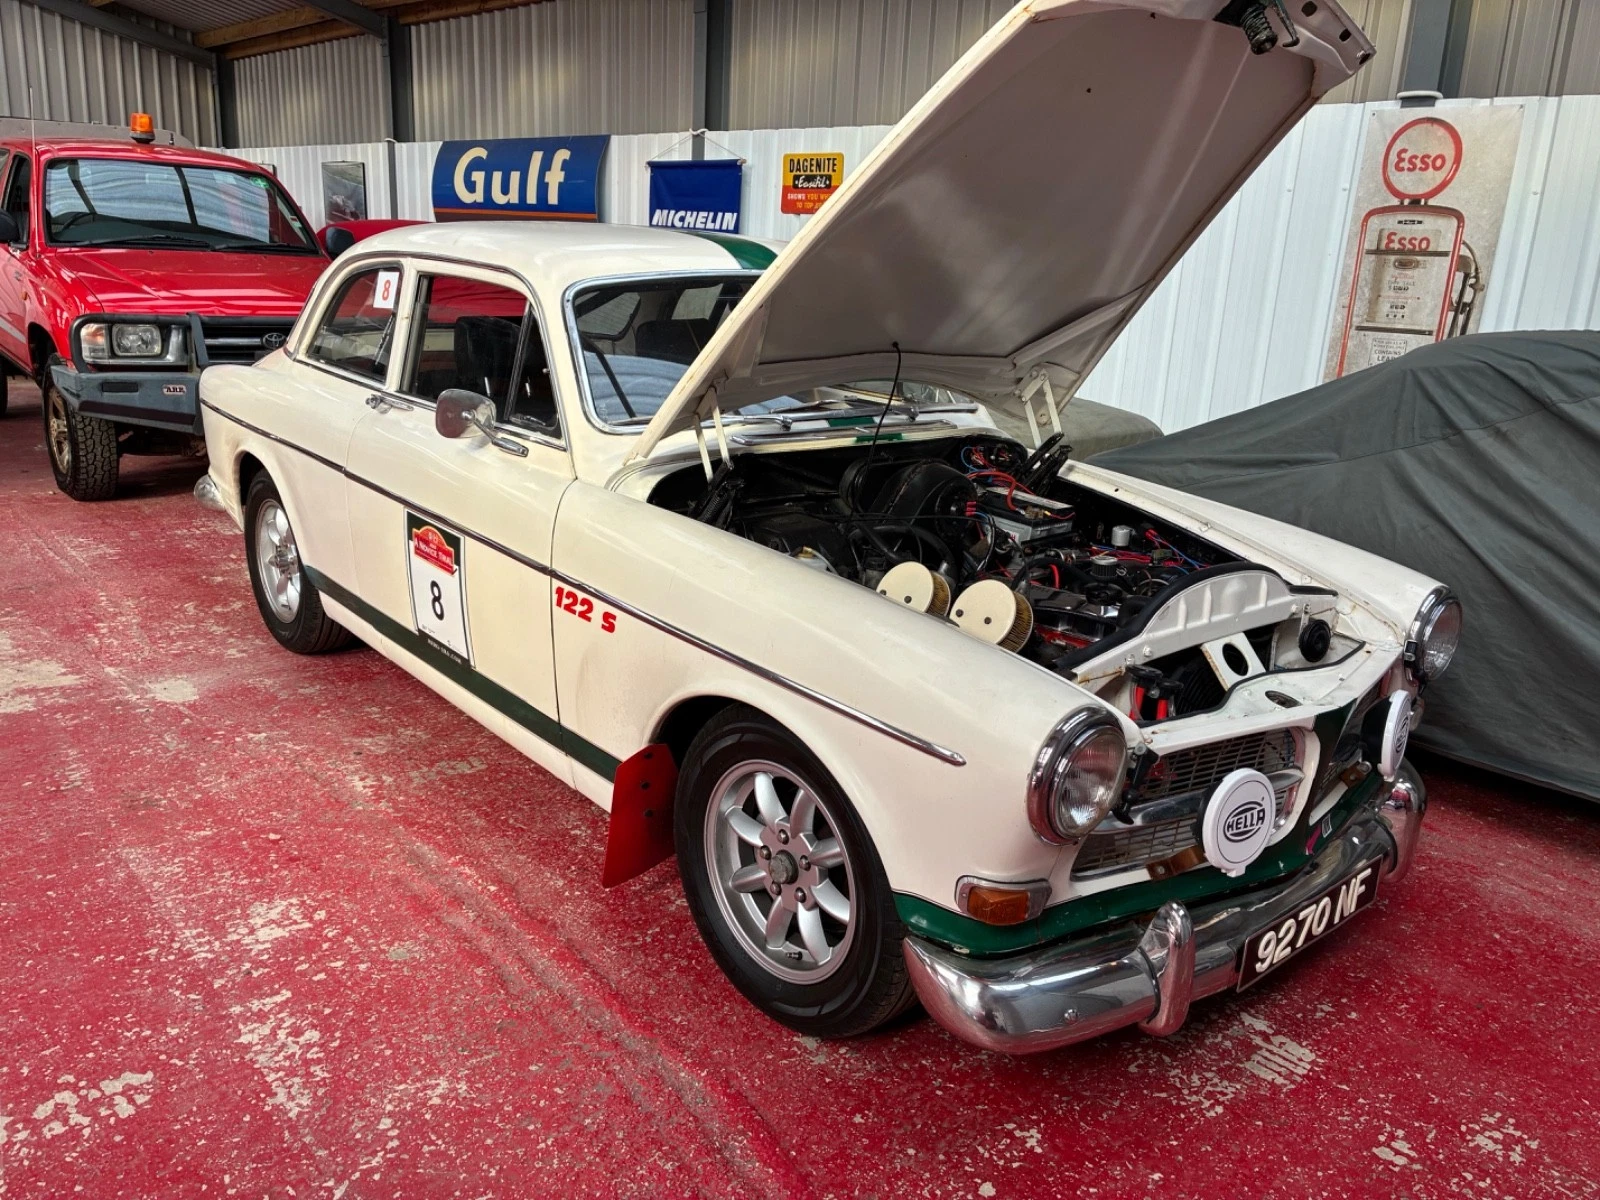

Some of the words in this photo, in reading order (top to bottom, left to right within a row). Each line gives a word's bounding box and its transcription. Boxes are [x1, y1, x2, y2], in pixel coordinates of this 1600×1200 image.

[789, 157, 837, 173] DAGENITE
[1394, 148, 1446, 172] Esso
[454, 147, 571, 205] Gulf
[652, 209, 738, 231] MICHELIN
[1384, 231, 1431, 251] Esso
[382, 279, 391, 302] 8
[430, 580, 445, 621] 8
[555, 586, 594, 623] 122
[601, 611, 617, 634] S
[1226, 807, 1266, 833] HELLA
[1255, 896, 1332, 973] 9270
[1333, 867, 1372, 925] NF
